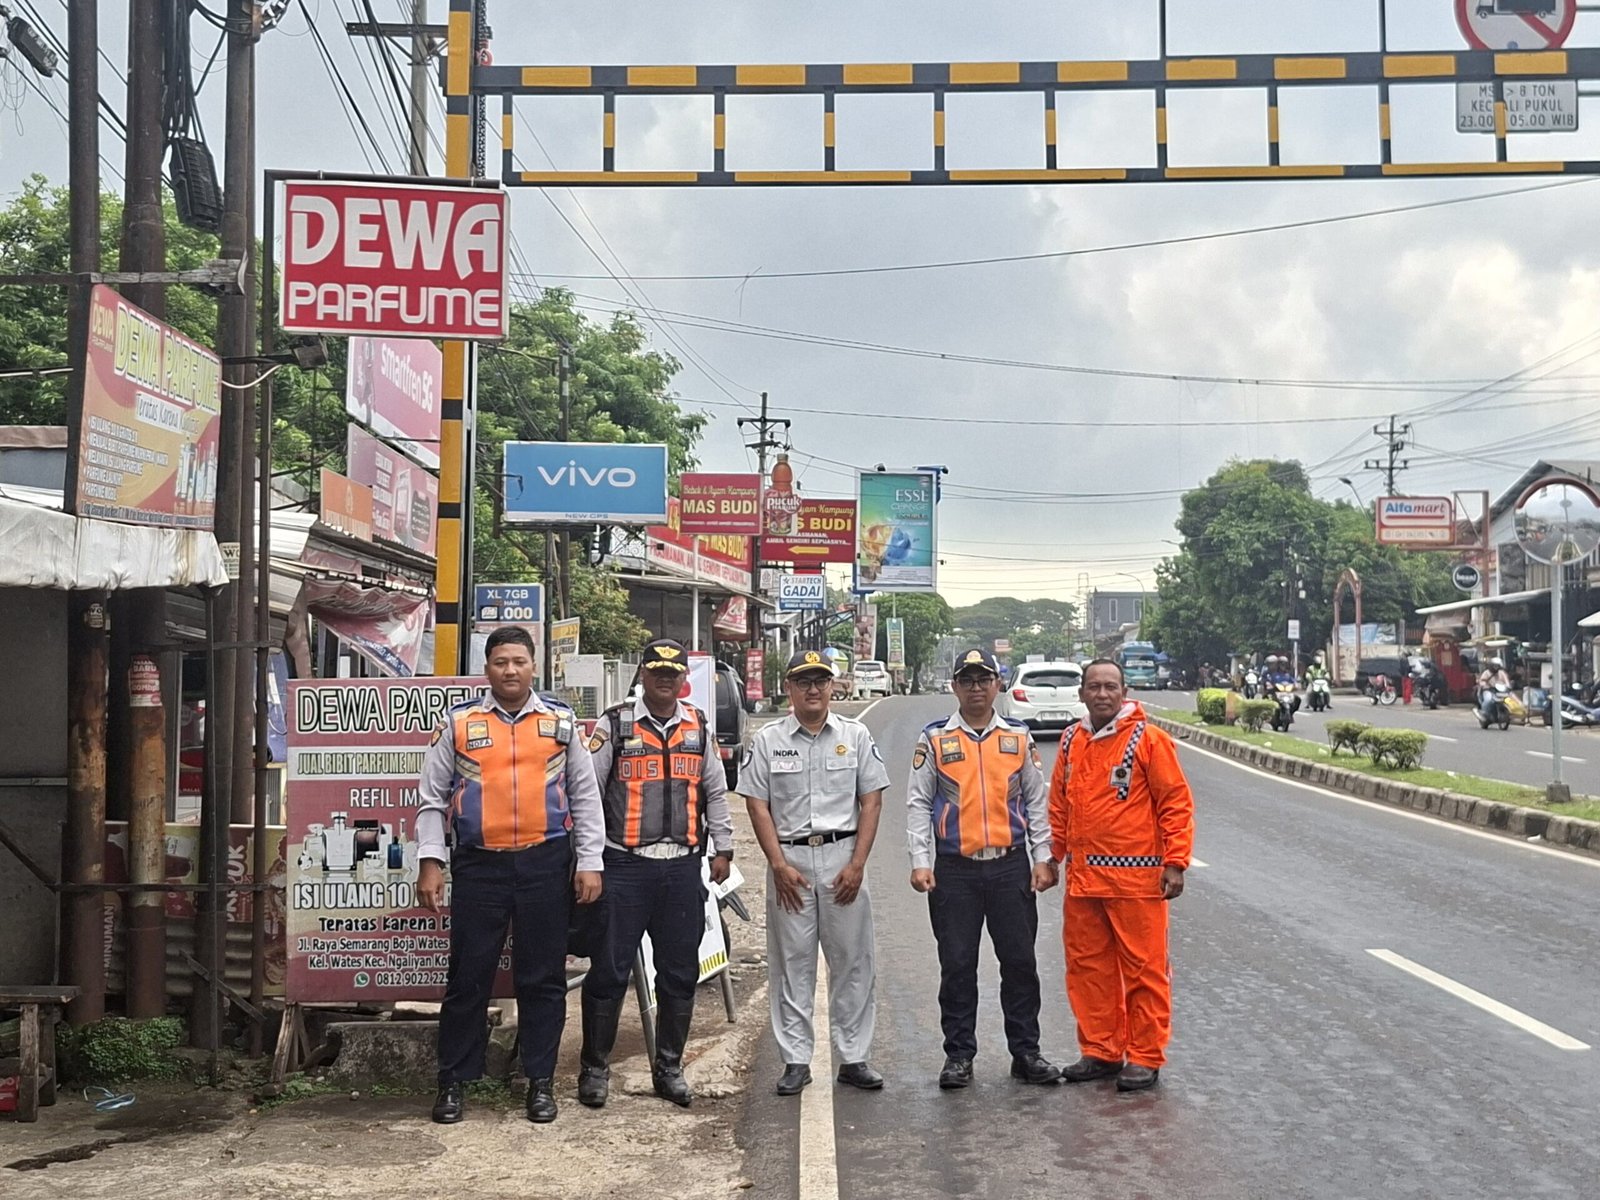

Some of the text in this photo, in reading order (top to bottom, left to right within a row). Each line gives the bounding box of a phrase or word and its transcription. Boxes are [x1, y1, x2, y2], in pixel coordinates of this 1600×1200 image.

[1480, 86, 1494, 97] MS
[1520, 86, 1526, 97] 8
[1533, 86, 1555, 96] TON
[1472, 100, 1562, 111] KECLI PUKUL
[1510, 115, 1545, 126] 05.00
[1551, 115, 1574, 125] WIB
[290, 195, 500, 280] DEWA
[288, 281, 498, 326] PARFUME
[114, 301, 161, 393] DEWA
[381, 343, 433, 414] smartfren 5G
[537, 460, 636, 487] vivo
[727, 486, 757, 498] Kampung
[896, 489, 929, 502] ESSE
[683, 500, 758, 515] MAS BUDI
[767, 495, 800, 510] pucuk
[1385, 502, 1445, 513] Alfamart
[818, 505, 855, 517] Kampung
[810, 518, 851, 531] BUDI
[487, 589, 529, 599] XL 7GB
[783, 585, 821, 597] GADAI
[500, 607, 533, 620] .000
[298, 687, 490, 731] DEWA PARF
[468, 740, 491, 748] NOFA
[298, 753, 323, 775] JUAL
[324, 753, 354, 774] BIBIT
[355, 752, 405, 774] PARFUME
[350, 788, 394, 807] REFIL
[294, 883, 320, 909] ISI
[323, 882, 385, 908] ULANG
[388, 881, 411, 908] 10
[319, 917, 377, 931] Teratas
[382, 917, 436, 930] Karena
[103, 904, 115, 968] MINUMAN
[299, 936, 449, 952] Jl. Raya Semarang Boja Wates
[309, 954, 450, 969] Kel. Wates Kec. Ngaliyan Ko
[377, 971, 449, 985] 0812 9022 22
